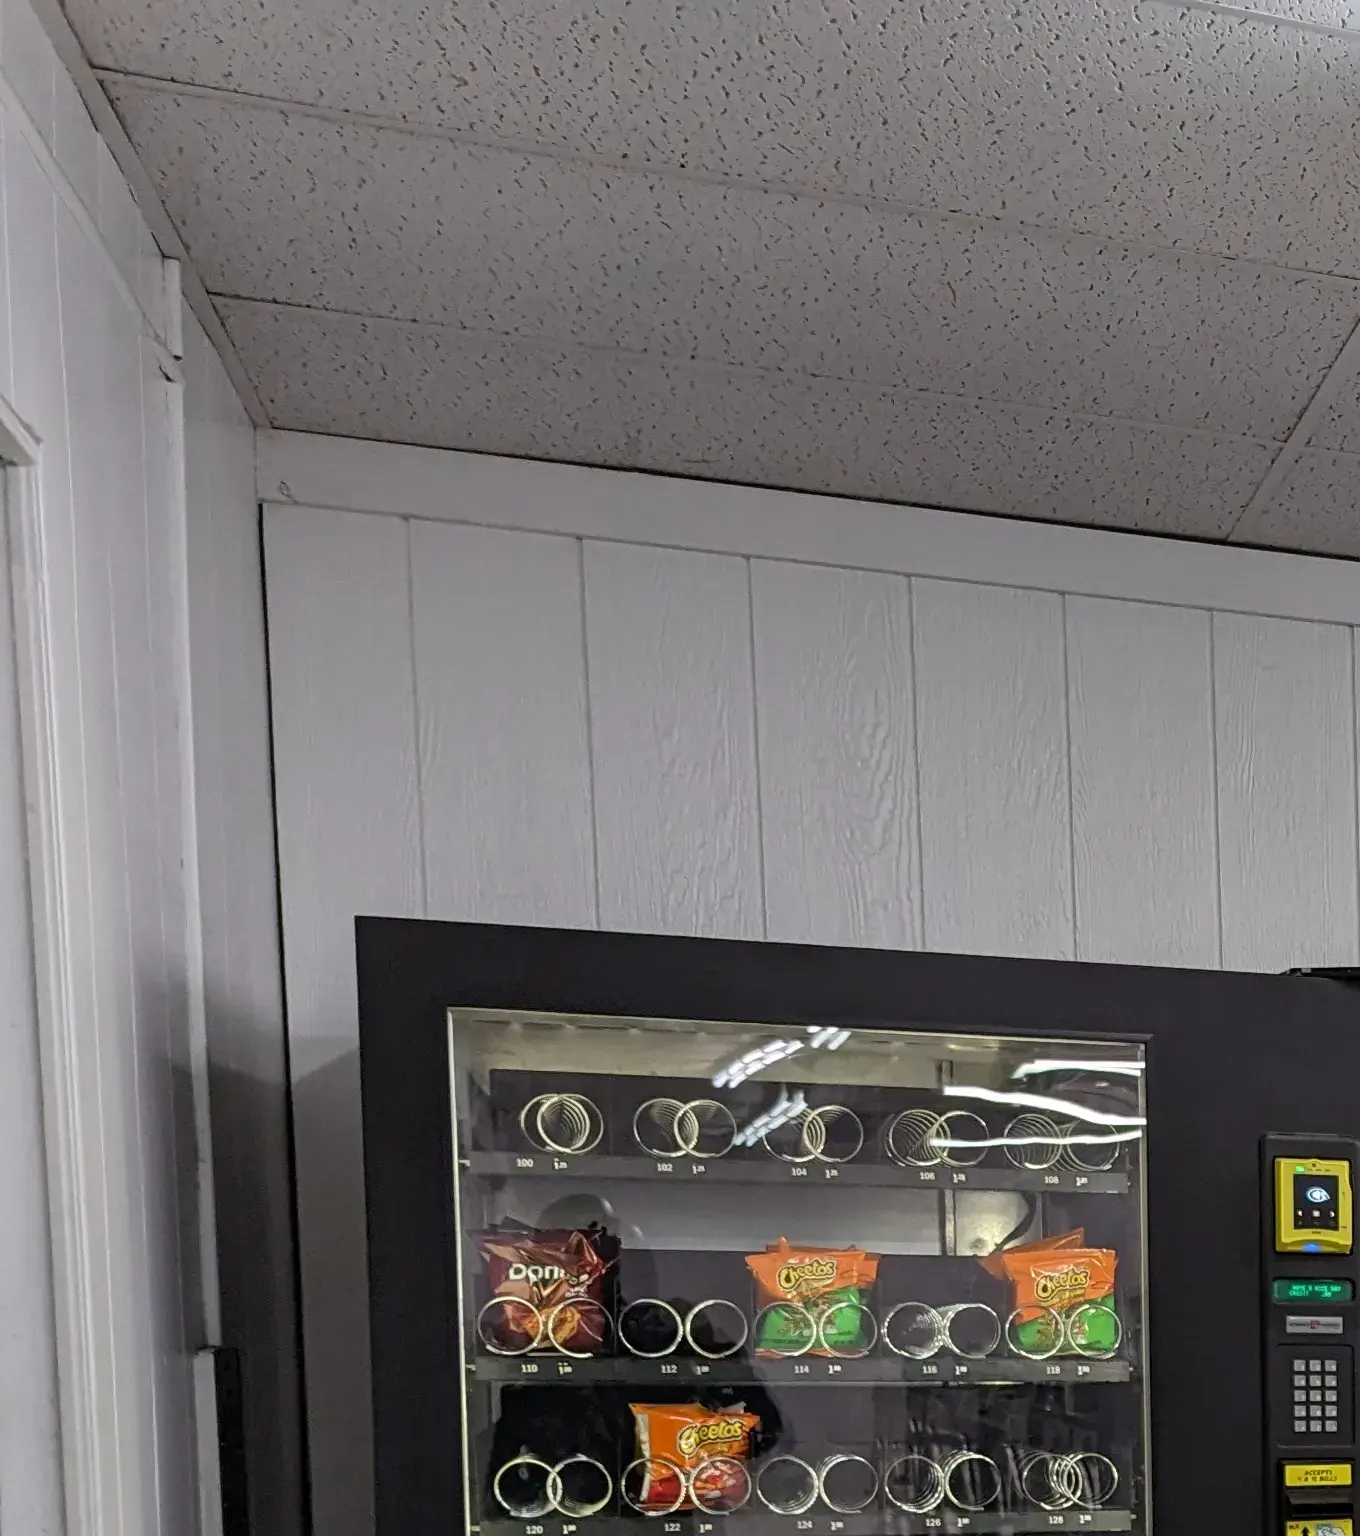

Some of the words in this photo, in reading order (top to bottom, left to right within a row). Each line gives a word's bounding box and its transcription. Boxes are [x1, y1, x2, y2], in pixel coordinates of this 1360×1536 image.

[779, 1260, 836, 1290] Cheetos
[1036, 1268, 1089, 1300] Cheetos
[661, 1365, 678, 1374] 112
[926, 1518, 941, 1526] 126
[1048, 1515, 1064, 1524] 128
[526, 1525, 543, 1535] 120
[664, 1523, 681, 1532] 122
